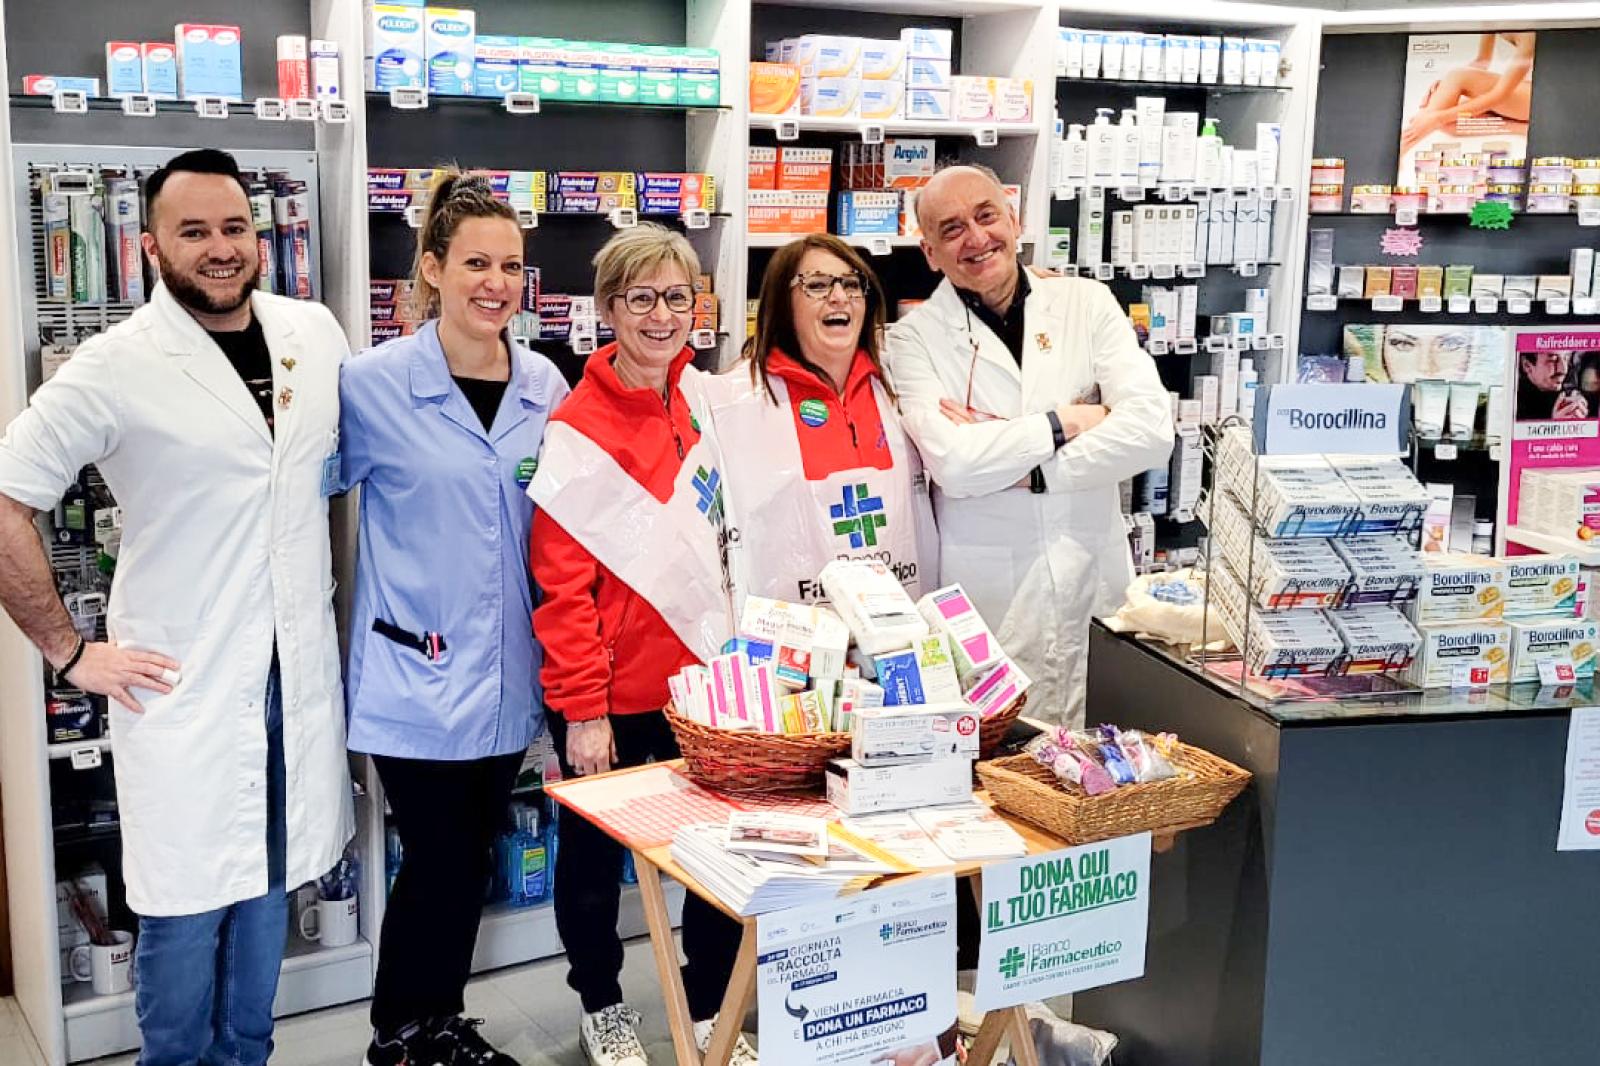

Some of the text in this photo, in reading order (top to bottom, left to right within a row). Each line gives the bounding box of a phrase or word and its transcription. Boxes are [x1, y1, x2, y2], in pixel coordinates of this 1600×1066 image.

[893, 144, 928, 163] Argivit
[1536, 335, 1588, 349] Raffreddore
[1290, 408, 1386, 429] Borocillina
[1432, 572, 1491, 586] Borocillina
[1510, 564, 1565, 577] Borocillina
[1289, 577, 1346, 588] Borocillina
[1439, 632, 1496, 647] Borocillina
[1529, 628, 1585, 642] Borocillina
[1020, 849, 1109, 893] DONA QUI
[987, 870, 1137, 929] IL TUO FARMACO
[789, 936, 841, 957] GIORNATA
[1031, 940, 1122, 972] Farmaceutico
[1032, 939, 1070, 956] Banco
[776, 947, 842, 973] RACCOLTA
[780, 962, 829, 984] FARMACO
[812, 987, 905, 1018] VIENI IN FARMACIA
[807, 1018, 844, 1038] DONA
[845, 1011, 863, 1028] UN
[866, 996, 924, 1023] FARMACO
[816, 1041, 823, 1050] A
[824, 1035, 843, 1048] CHI
[845, 1031, 859, 1044] HA
[861, 1020, 905, 1040] BISOGNO
